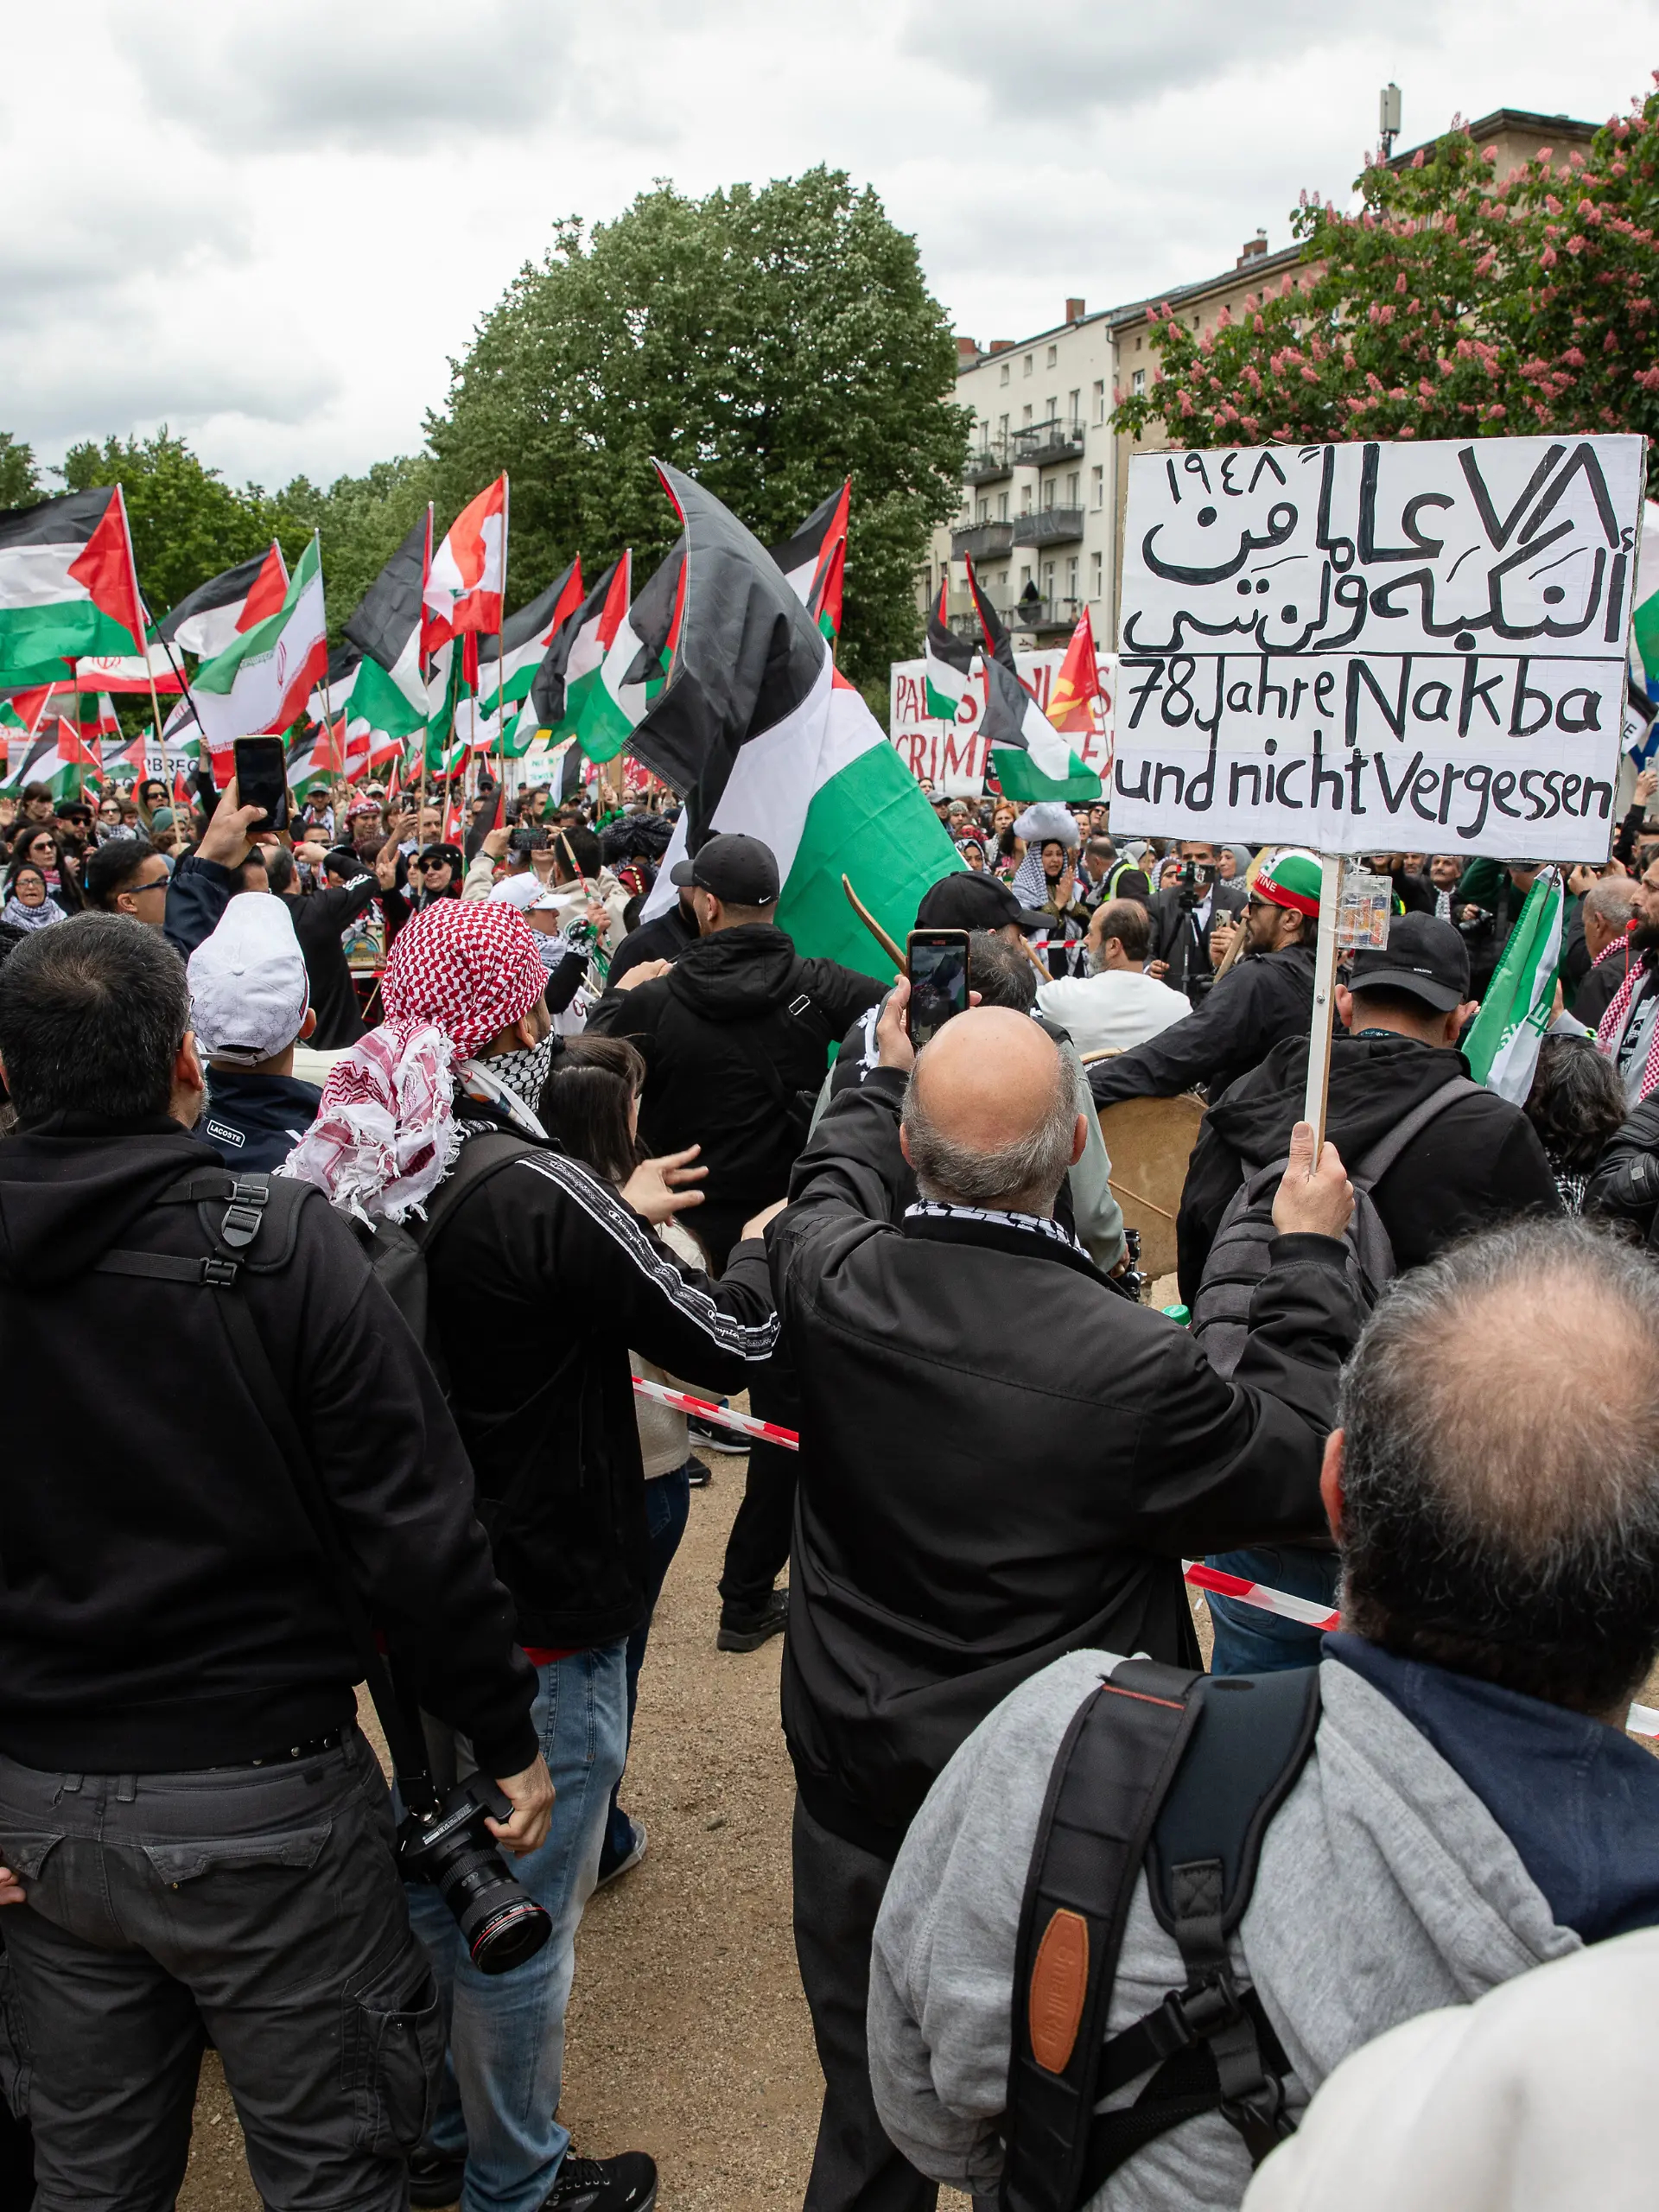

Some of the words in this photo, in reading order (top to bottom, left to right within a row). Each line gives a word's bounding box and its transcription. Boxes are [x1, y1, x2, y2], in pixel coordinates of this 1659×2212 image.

[1141, 501, 1299, 586] من
[1117, 657, 1196, 729] 78
[1195, 655, 1335, 733] Jahre
[1344, 655, 1603, 748] Nakba
[1115, 733, 1218, 813] und
[1229, 729, 1369, 816] nicht
[1374, 750, 1613, 841] Vergessen
[210, 1124, 242, 1143] LACOSTE
[608, 1210, 645, 1255] Champion
